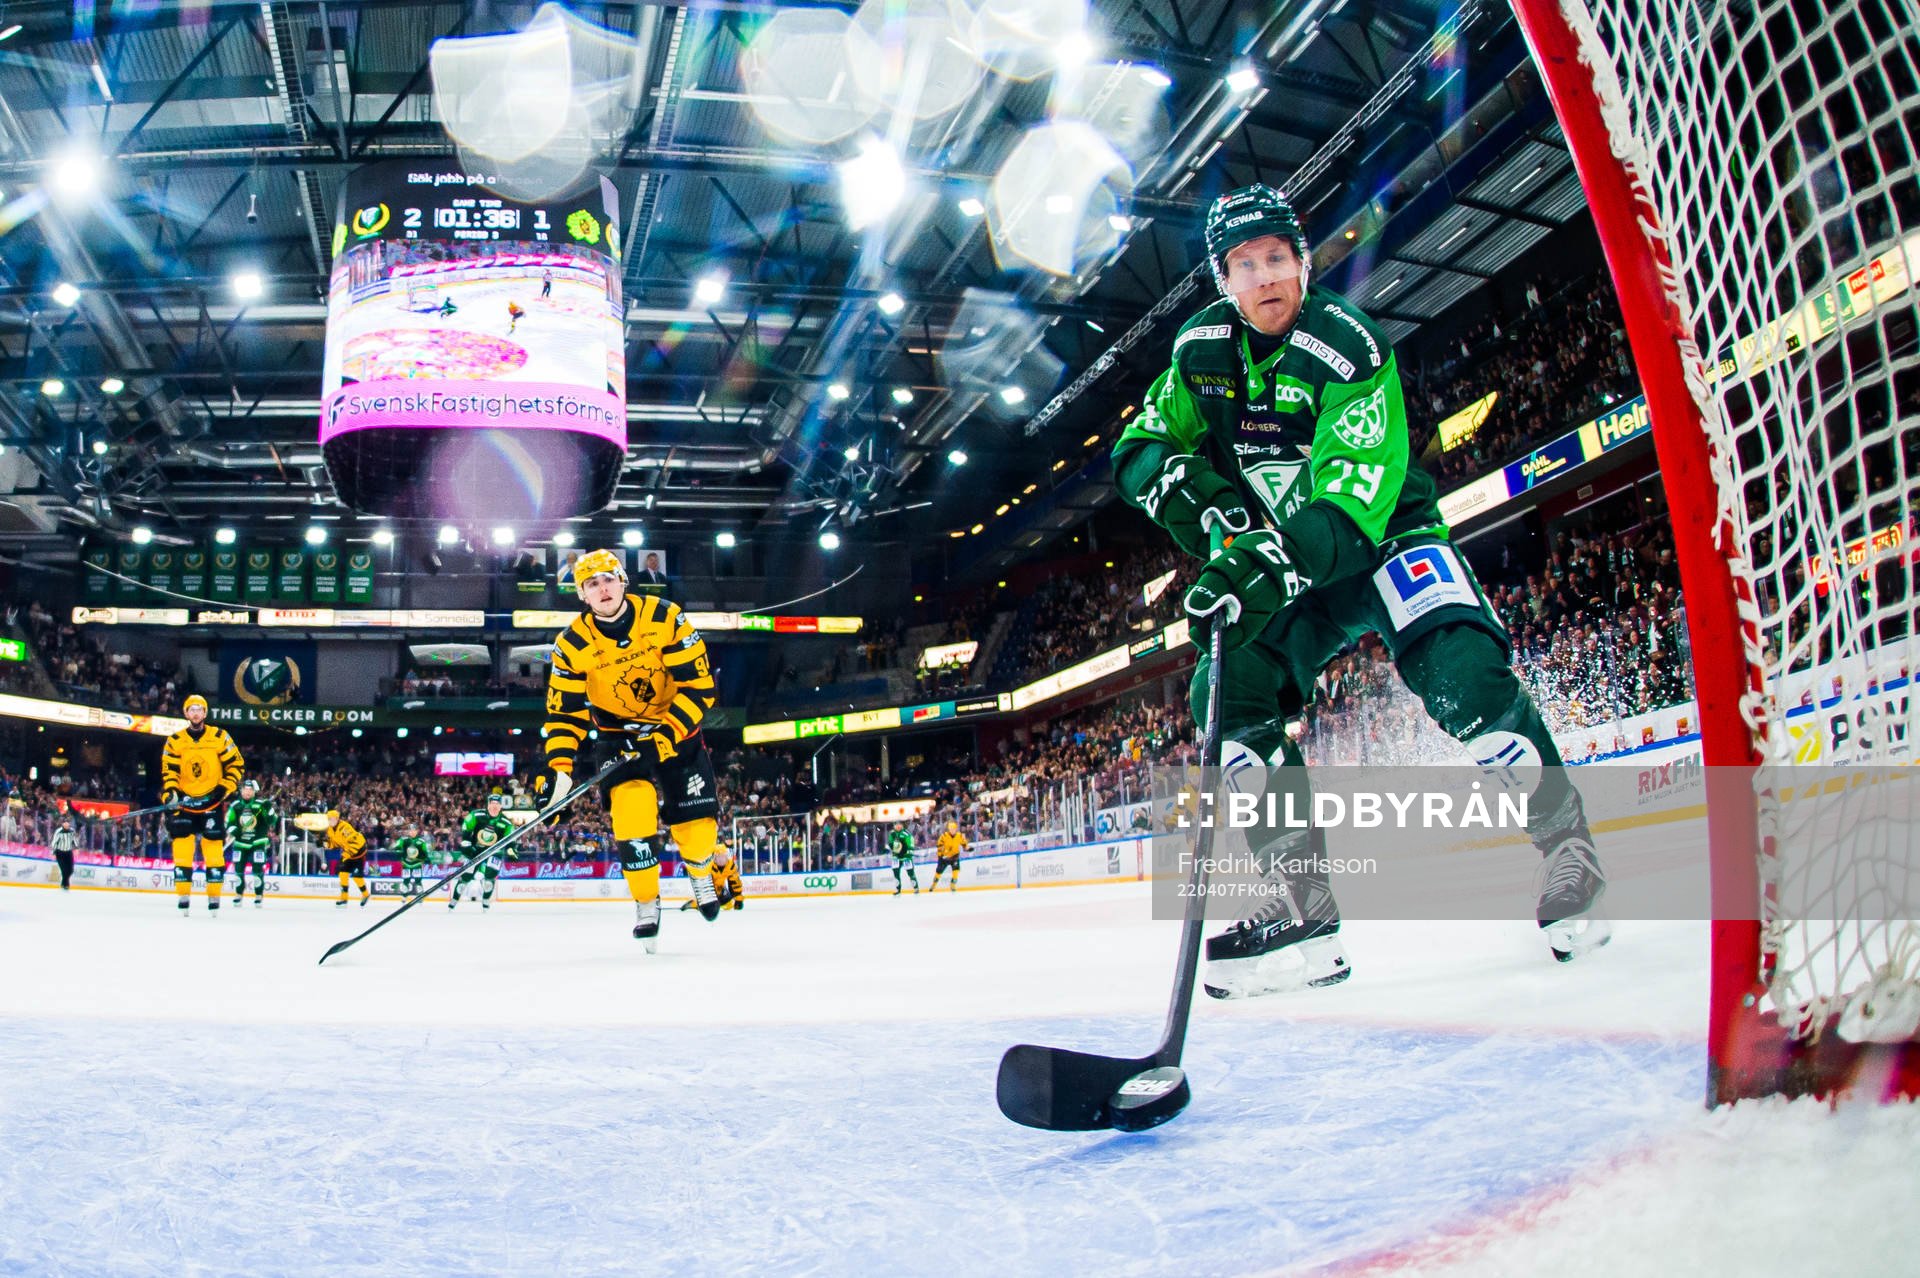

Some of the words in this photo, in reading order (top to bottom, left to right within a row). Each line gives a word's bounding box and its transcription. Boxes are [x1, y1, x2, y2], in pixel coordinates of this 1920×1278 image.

[434, 173, 465, 187] jobb
[466, 173, 485, 186] på
[403, 207, 422, 228] 2
[533, 210, 551, 229] 1
[1225, 211, 1264, 229] KEWAB
[211, 708, 242, 719] THE
[249, 708, 315, 721] LOCKER
[322, 710, 374, 722] ROOM
[800, 715, 840, 737] print
[1456, 716, 1483, 739] CCM
[804, 875, 837, 891] coop
